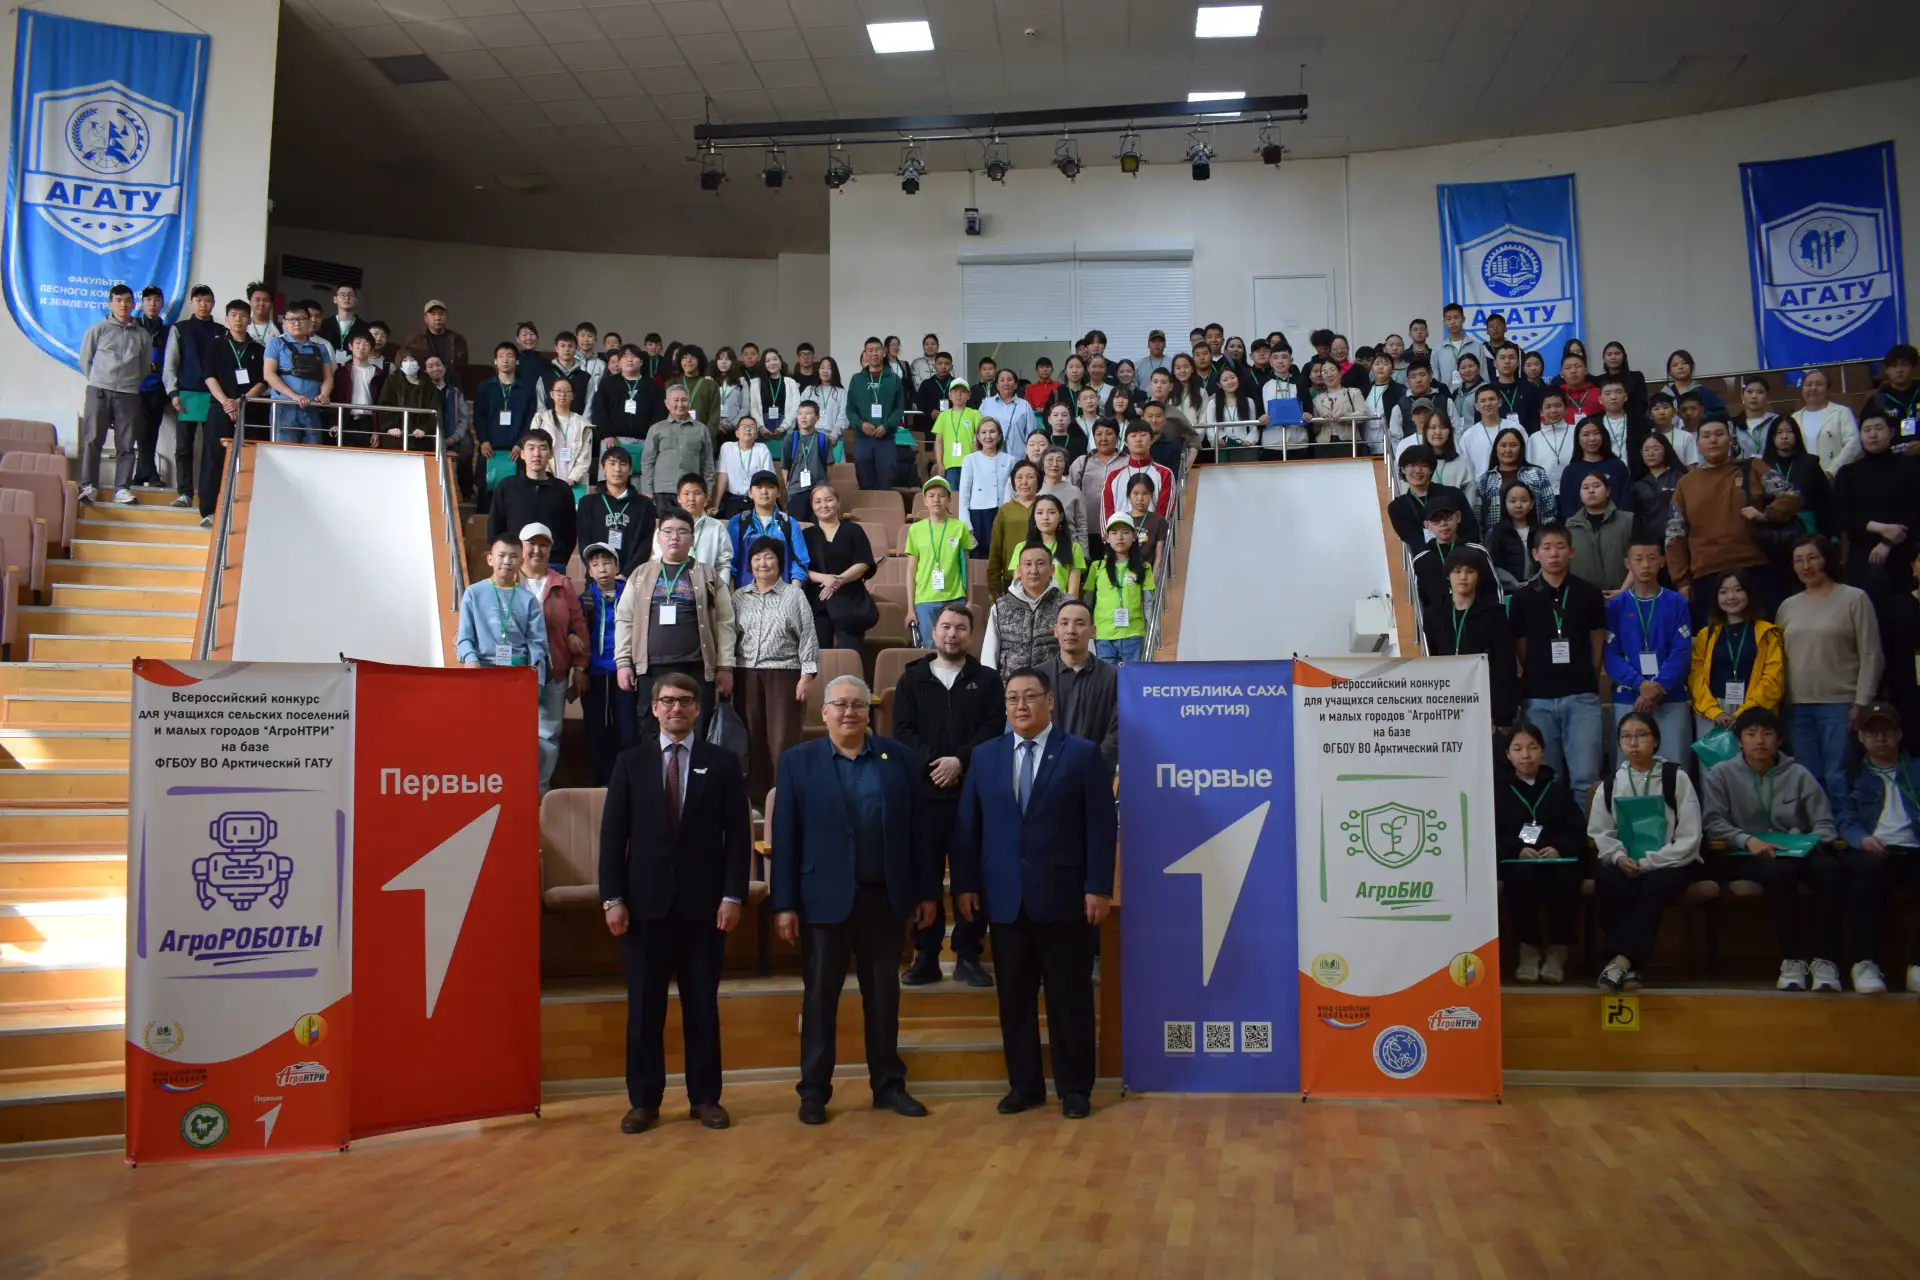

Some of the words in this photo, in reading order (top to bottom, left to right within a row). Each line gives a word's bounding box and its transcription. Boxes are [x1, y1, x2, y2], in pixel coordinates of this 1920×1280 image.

[45, 180, 163, 212] АГАТУ
[40, 284, 88, 297] ЛЕСНОГО
[1780, 279, 1874, 307] АГАТУ
[40, 297, 47, 305] И
[1142, 685, 1243, 697] РЕСПУБЛИКА
[1246, 685, 1287, 697] САХА
[1331, 677, 1408, 691] Всероссийский
[1410, 678, 1451, 691] конкурс
[172, 691, 267, 704] Всероссийский
[271, 694, 320, 705] конкурс
[1303, 696, 1322, 707] для
[1325, 696, 1374, 708] учащихся
[1376, 695, 1423, 705] сельских
[1426, 692, 1480, 704] поселений
[138, 709, 160, 720] для
[163, 709, 224, 721] учащихся
[228, 710, 283, 720] сельских
[286, 709, 350, 721] поселений
[1180, 704, 1250, 718] (ЯКУТИЯ)
[1319, 713, 1326, 722] и
[1328, 711, 1362, 722] малых
[1365, 711, 1405, 723] городов
[154, 726, 162, 735] и
[166, 726, 206, 736] малых
[210, 726, 260, 738] городов
[1373, 728, 1385, 737] на
[1388, 726, 1411, 737] базе
[221, 742, 237, 752] на
[240, 741, 270, 752] базе
[1323, 742, 1355, 754] ФГБОУ
[1358, 742, 1371, 754] ВО
[1374, 741, 1439, 756] Арктический
[1441, 741, 1463, 753] ГАТУ
[155, 757, 197, 769] ФГБОУ
[200, 757, 218, 769] ВО
[221, 757, 301, 770] Арктический
[304, 757, 333, 769] ГАТУ
[380, 767, 504, 801] Первые
[1156, 763, 1273, 796] Первые
[1355, 881, 1434, 902] АгроБИО
[158, 925, 324, 956] АгроРОБОТЫ
